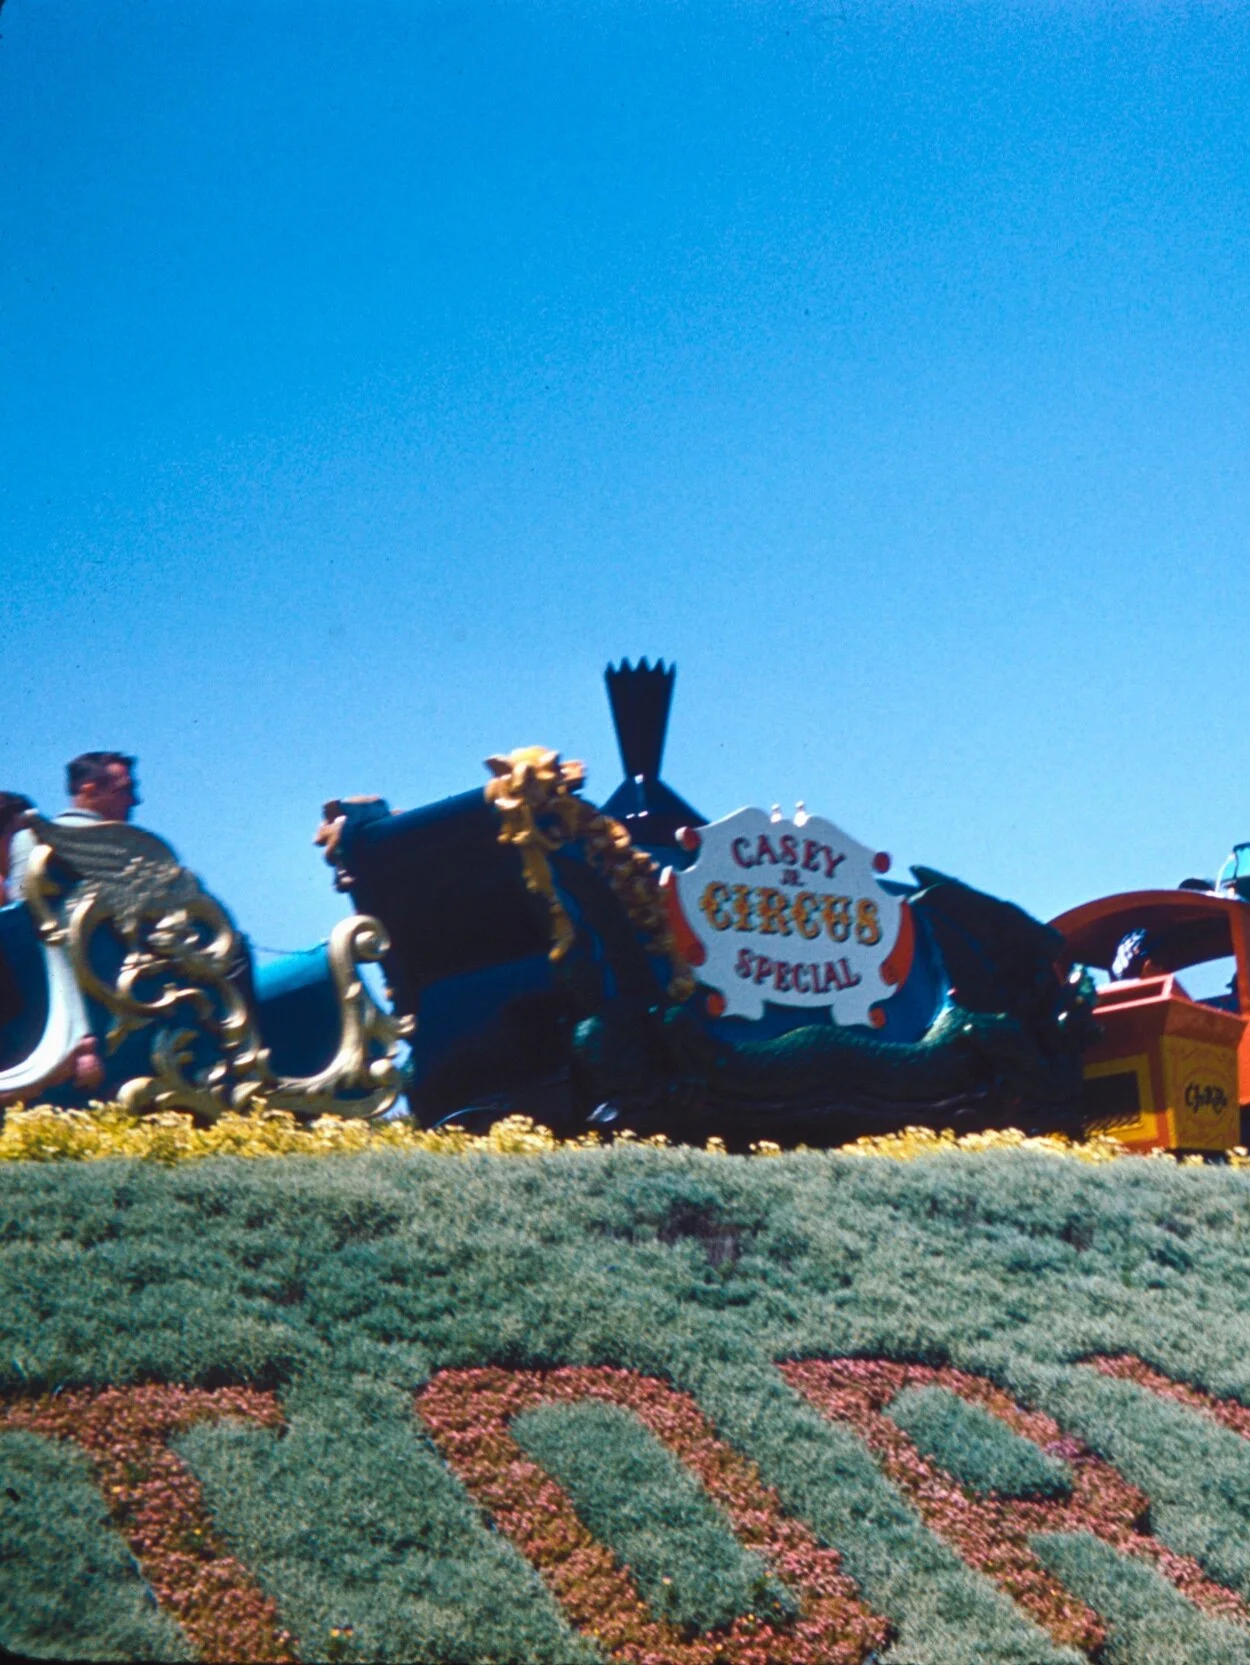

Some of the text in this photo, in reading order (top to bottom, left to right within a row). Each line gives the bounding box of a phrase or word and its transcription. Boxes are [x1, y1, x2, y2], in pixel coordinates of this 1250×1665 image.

[730, 834, 846, 878] CASEY
[699, 881, 881, 946] CIRCUS
[734, 948, 861, 994] SPECIAL
